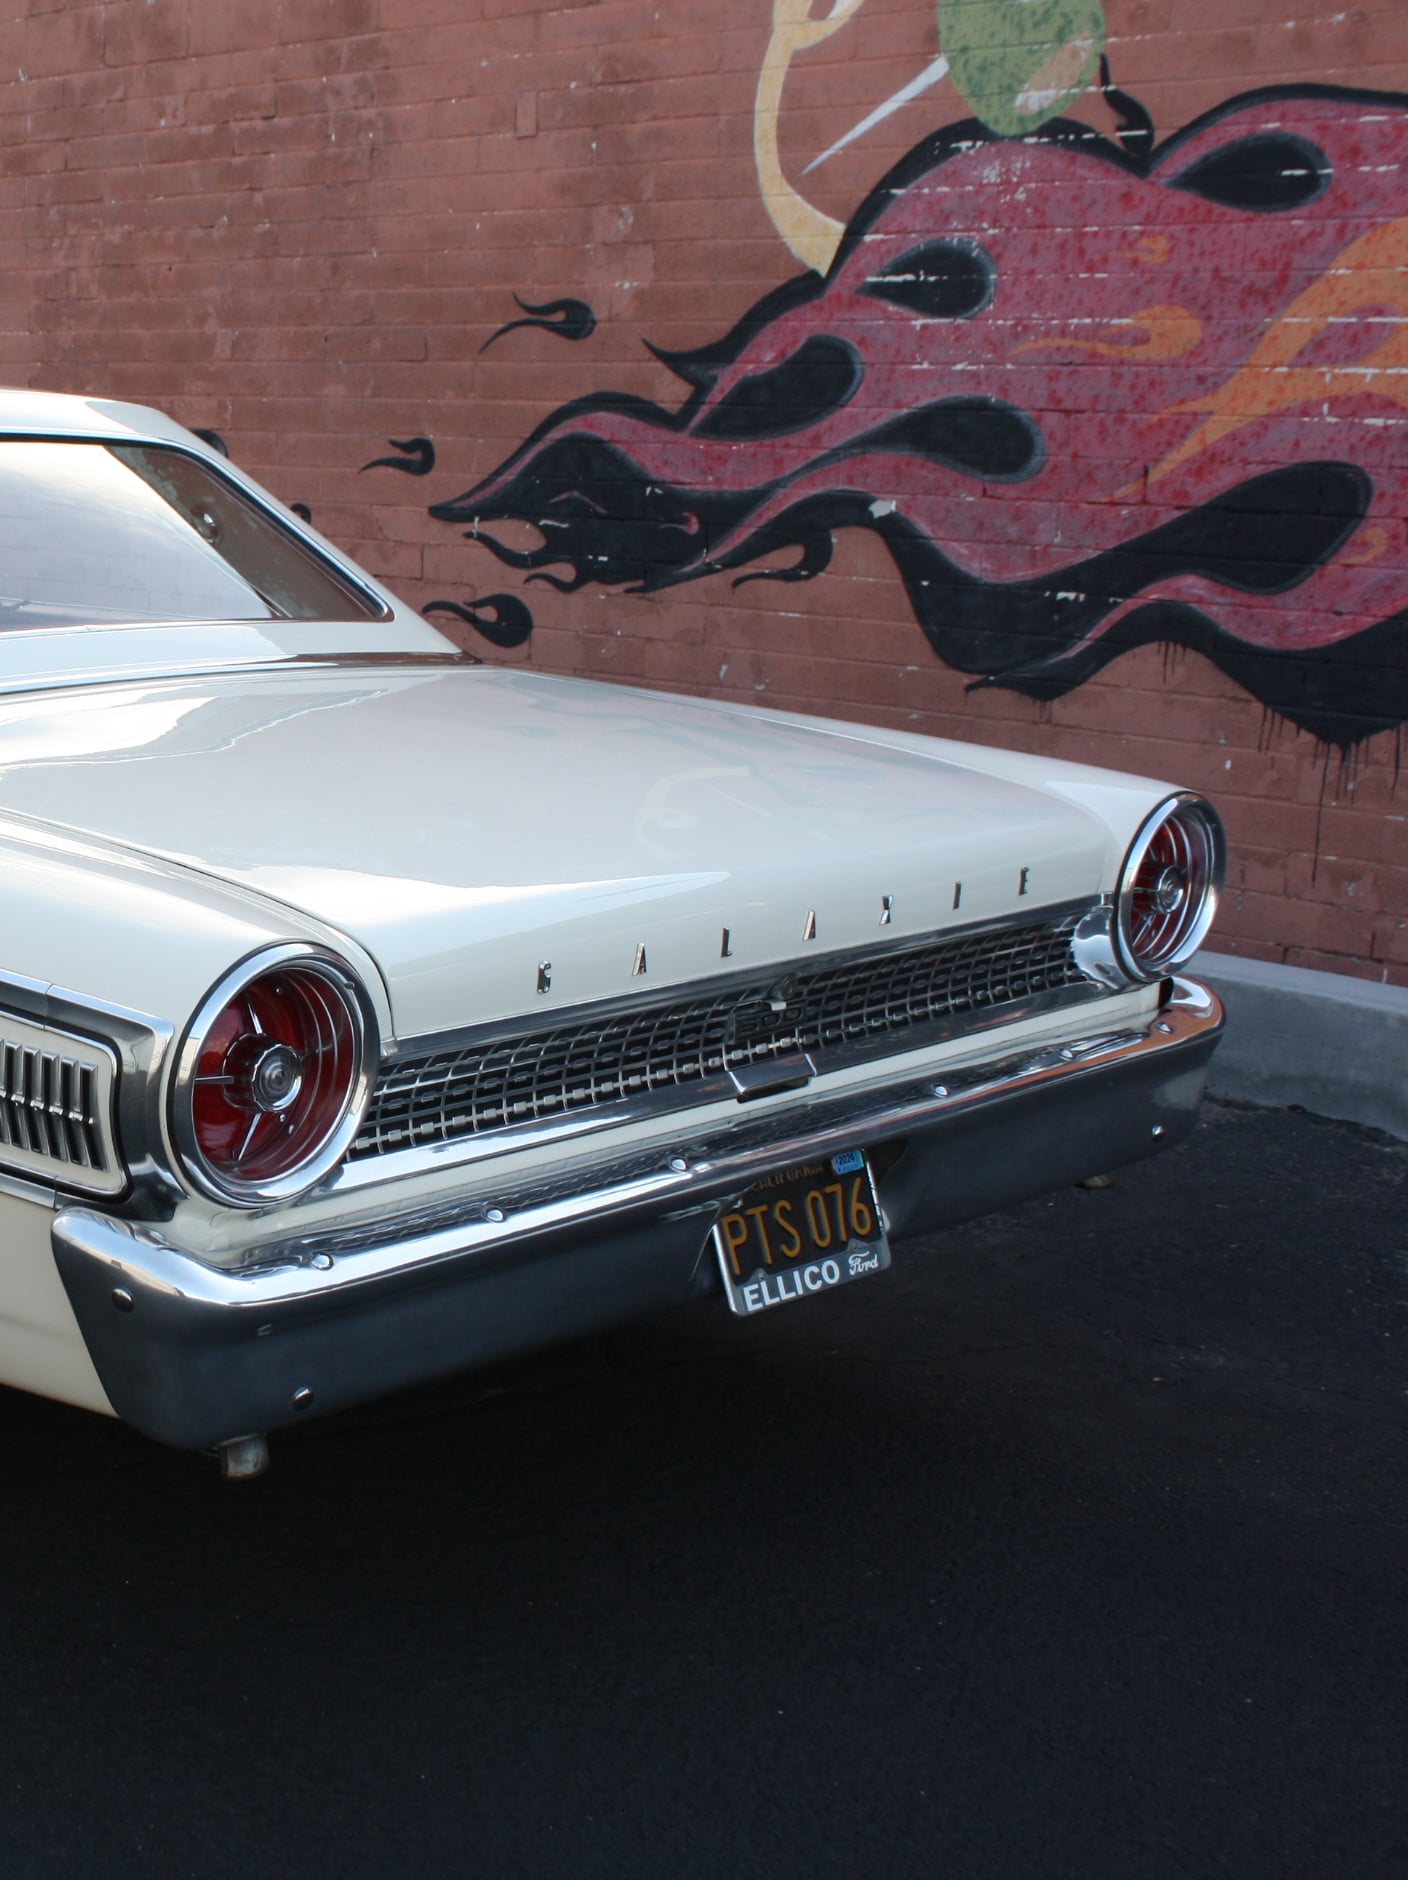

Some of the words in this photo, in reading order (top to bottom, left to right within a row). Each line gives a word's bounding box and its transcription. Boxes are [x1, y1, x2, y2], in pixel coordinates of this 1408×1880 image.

[721, 1200, 801, 1276] PTS
[805, 1177, 872, 1248] 076
[743, 1260, 840, 1312] ELLICO
[848, 1251, 879, 1275] Ford
